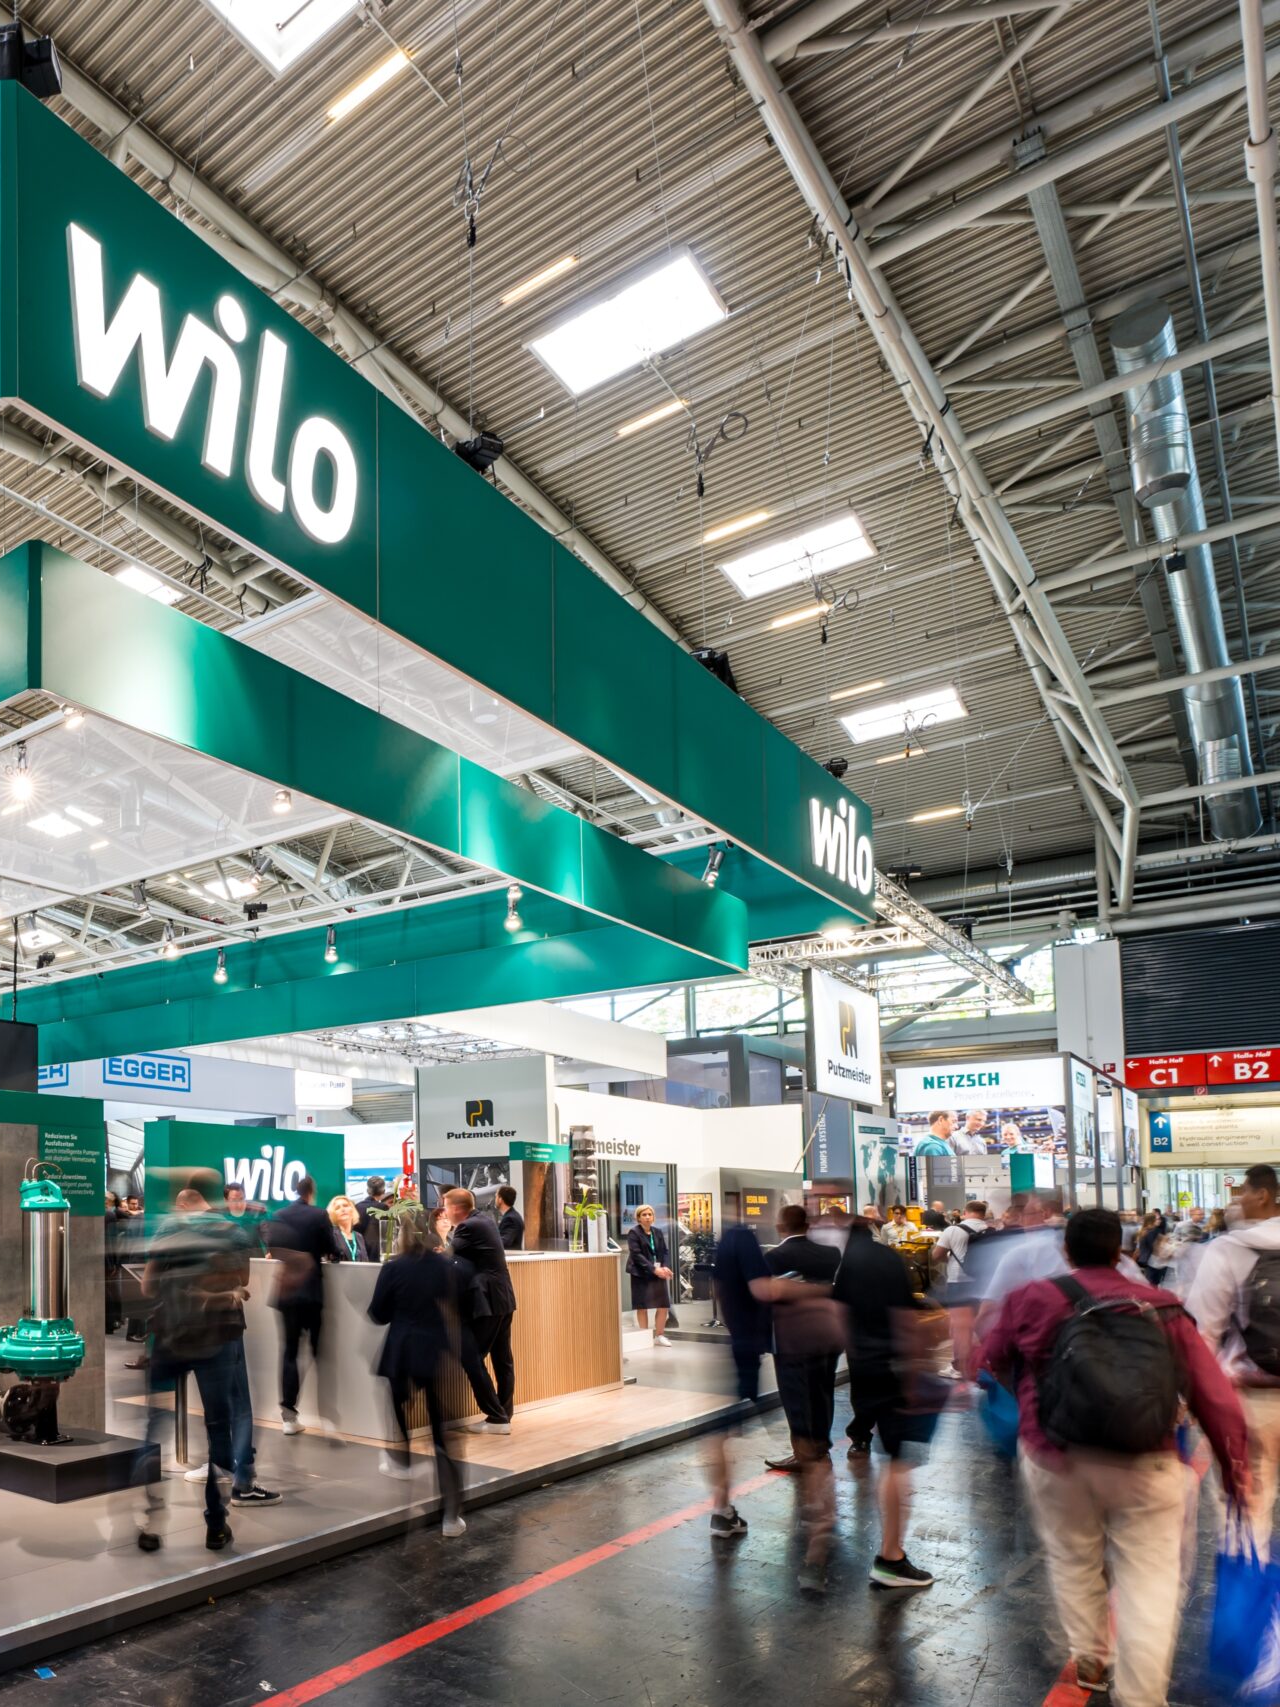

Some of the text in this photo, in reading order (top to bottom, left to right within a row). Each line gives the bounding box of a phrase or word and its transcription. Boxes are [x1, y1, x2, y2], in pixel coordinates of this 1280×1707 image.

[67, 222, 357, 543] wilo
[809, 798, 872, 895] wilo
[108, 1057, 186, 1083] EGGER
[827, 1059, 872, 1085] Putzmeister
[923, 1072, 1000, 1090] NETZSCH
[1149, 1068, 1178, 1085] C1
[1233, 1061, 1270, 1080] B2
[447, 1129, 516, 1140] Putzmeister
[561, 1133, 641, 1156] Pmeister
[1153, 1137, 1168, 1146] B2
[1215, 1134, 1261, 1142] engineering
[223, 1144, 307, 1201] wilo
[819, 1150, 828, 1173] PUMPS
